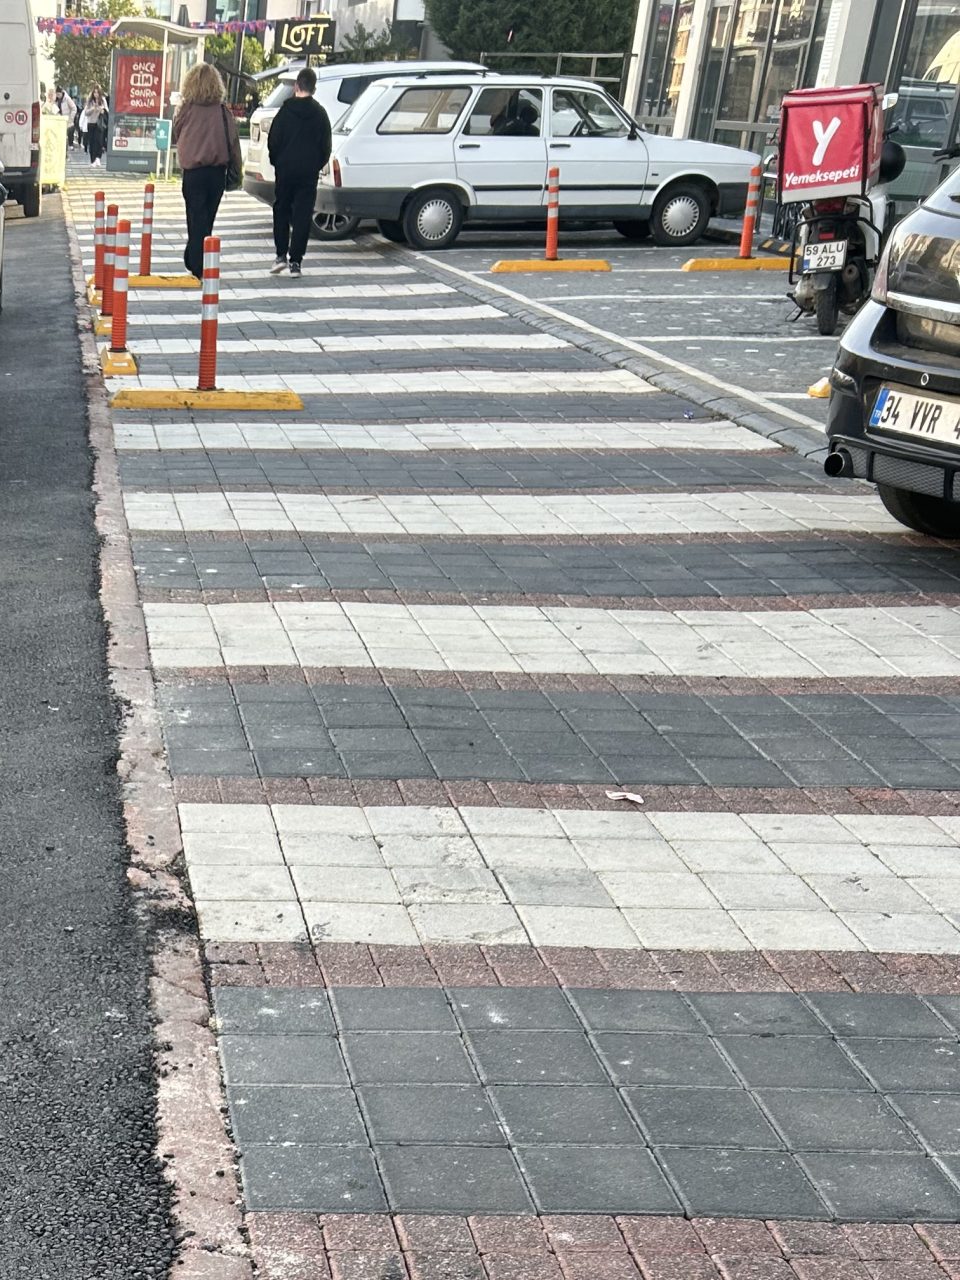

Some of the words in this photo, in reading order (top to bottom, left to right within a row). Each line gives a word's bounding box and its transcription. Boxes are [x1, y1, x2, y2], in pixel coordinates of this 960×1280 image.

[281, 23, 330, 52] LOFT
[812, 116, 842, 166] Y
[784, 164, 860, 188] Yemeksepeti
[806, 245, 819, 256] 59
[821, 242, 844, 255] ALU
[816, 255, 836, 267] 273
[880, 395, 903, 426] 34
[909, 400, 943, 434] VVR
